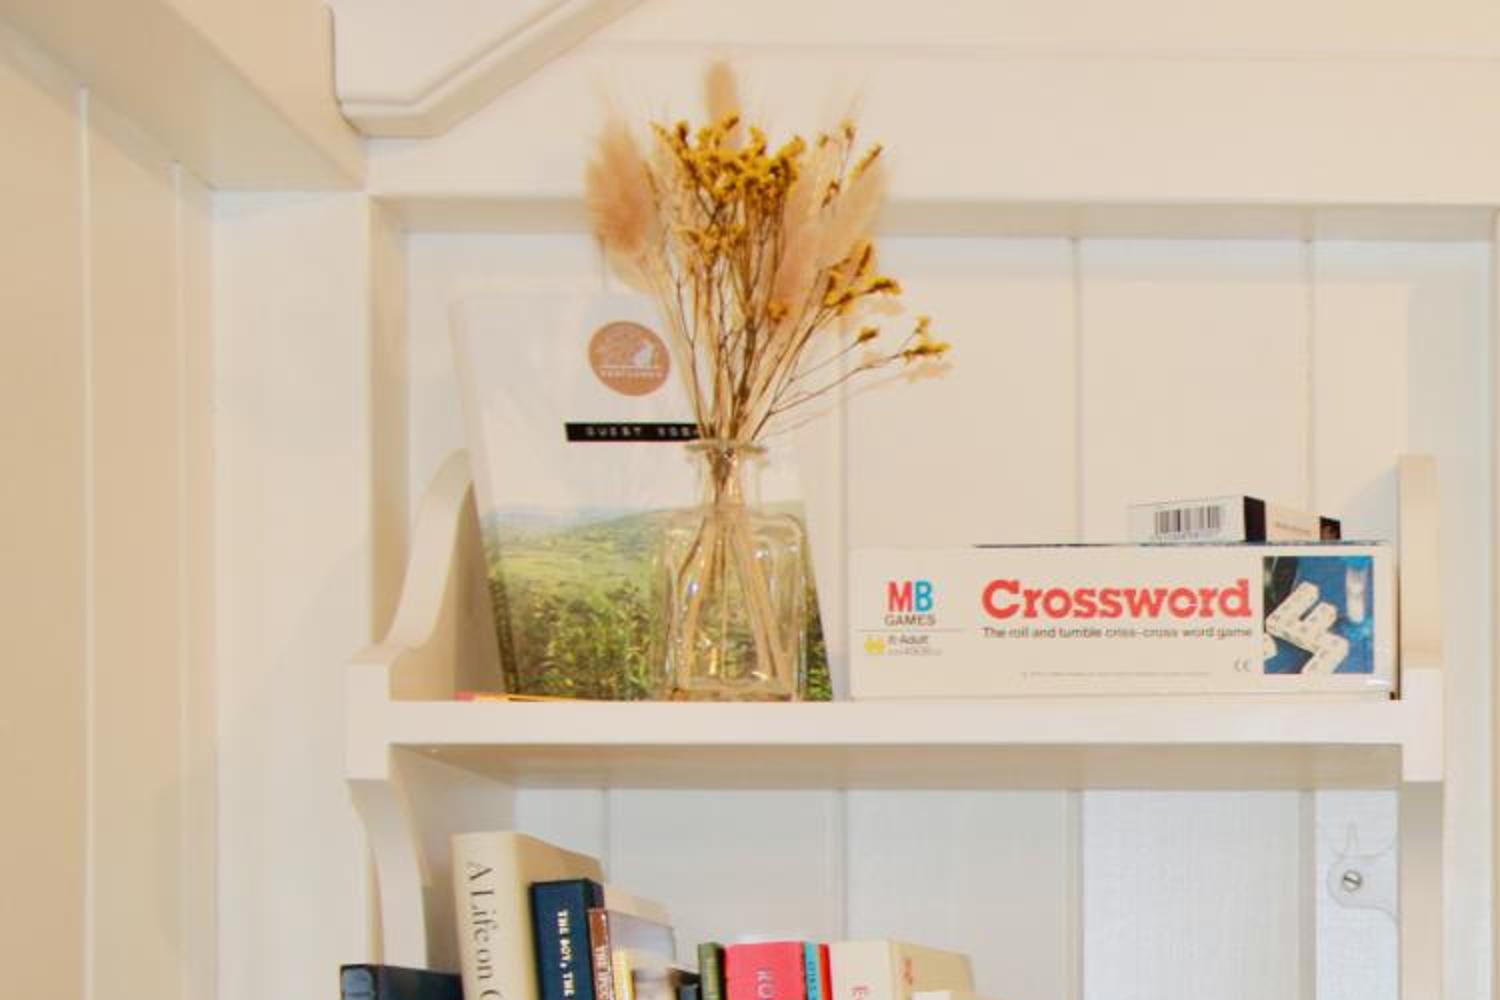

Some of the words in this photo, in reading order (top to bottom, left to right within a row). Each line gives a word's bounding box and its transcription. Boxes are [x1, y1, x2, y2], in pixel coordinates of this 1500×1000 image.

[886, 580, 936, 613] MB
[981, 578, 1253, 620] Crossword
[883, 613, 937, 627] GAMES
[982, 626, 1005, 639] The
[1008, 626, 1029, 639] roll
[1033, 626, 1056, 639] and
[1059, 626, 1102, 639] tumble
[1104, 626, 1179, 639] criss-cross
[1183, 626, 1214, 639] word
[1217, 628, 1253, 641] game
[467, 861, 494, 881] A
[469, 889, 498, 944] Life
[557, 910, 570, 935] THE
[475, 949, 496, 981] on
[559, 938, 571, 968] BOY,
[563, 971, 575, 997] THE
